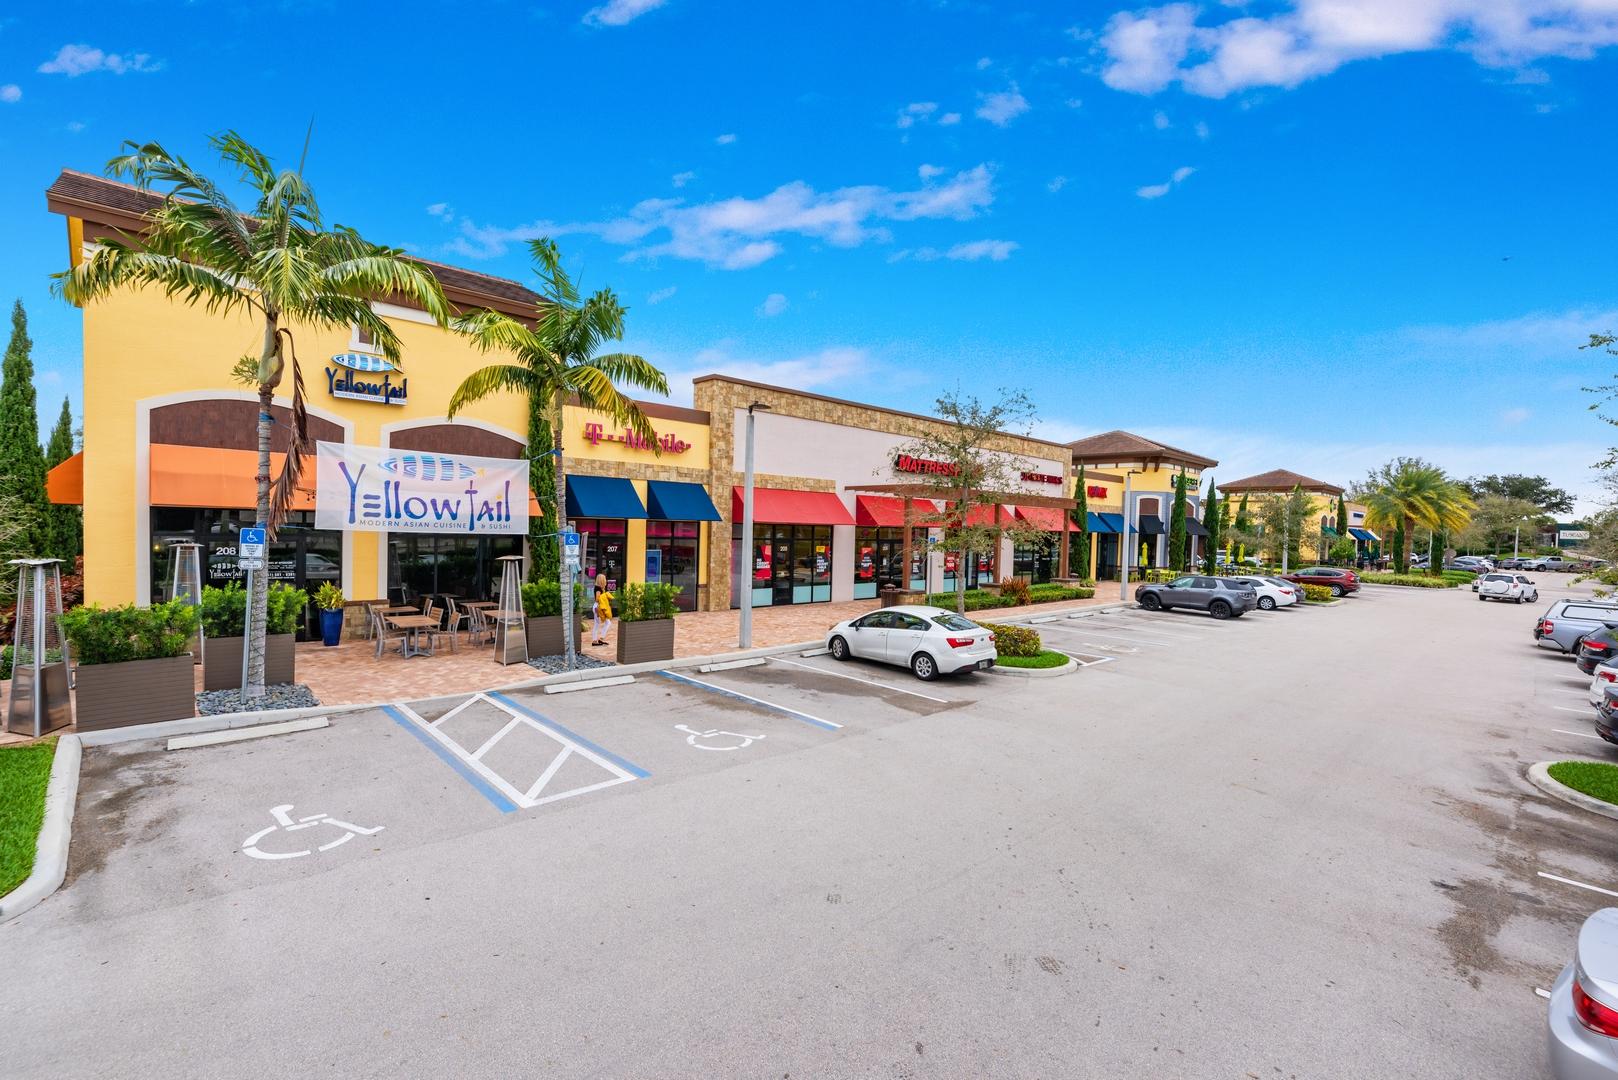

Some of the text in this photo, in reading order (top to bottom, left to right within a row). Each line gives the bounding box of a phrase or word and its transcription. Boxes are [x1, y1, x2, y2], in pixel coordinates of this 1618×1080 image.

[898, 454, 956, 477] MATTRESS
[359, 519, 400, 527] MODERN
[216, 547, 236, 555] 208
